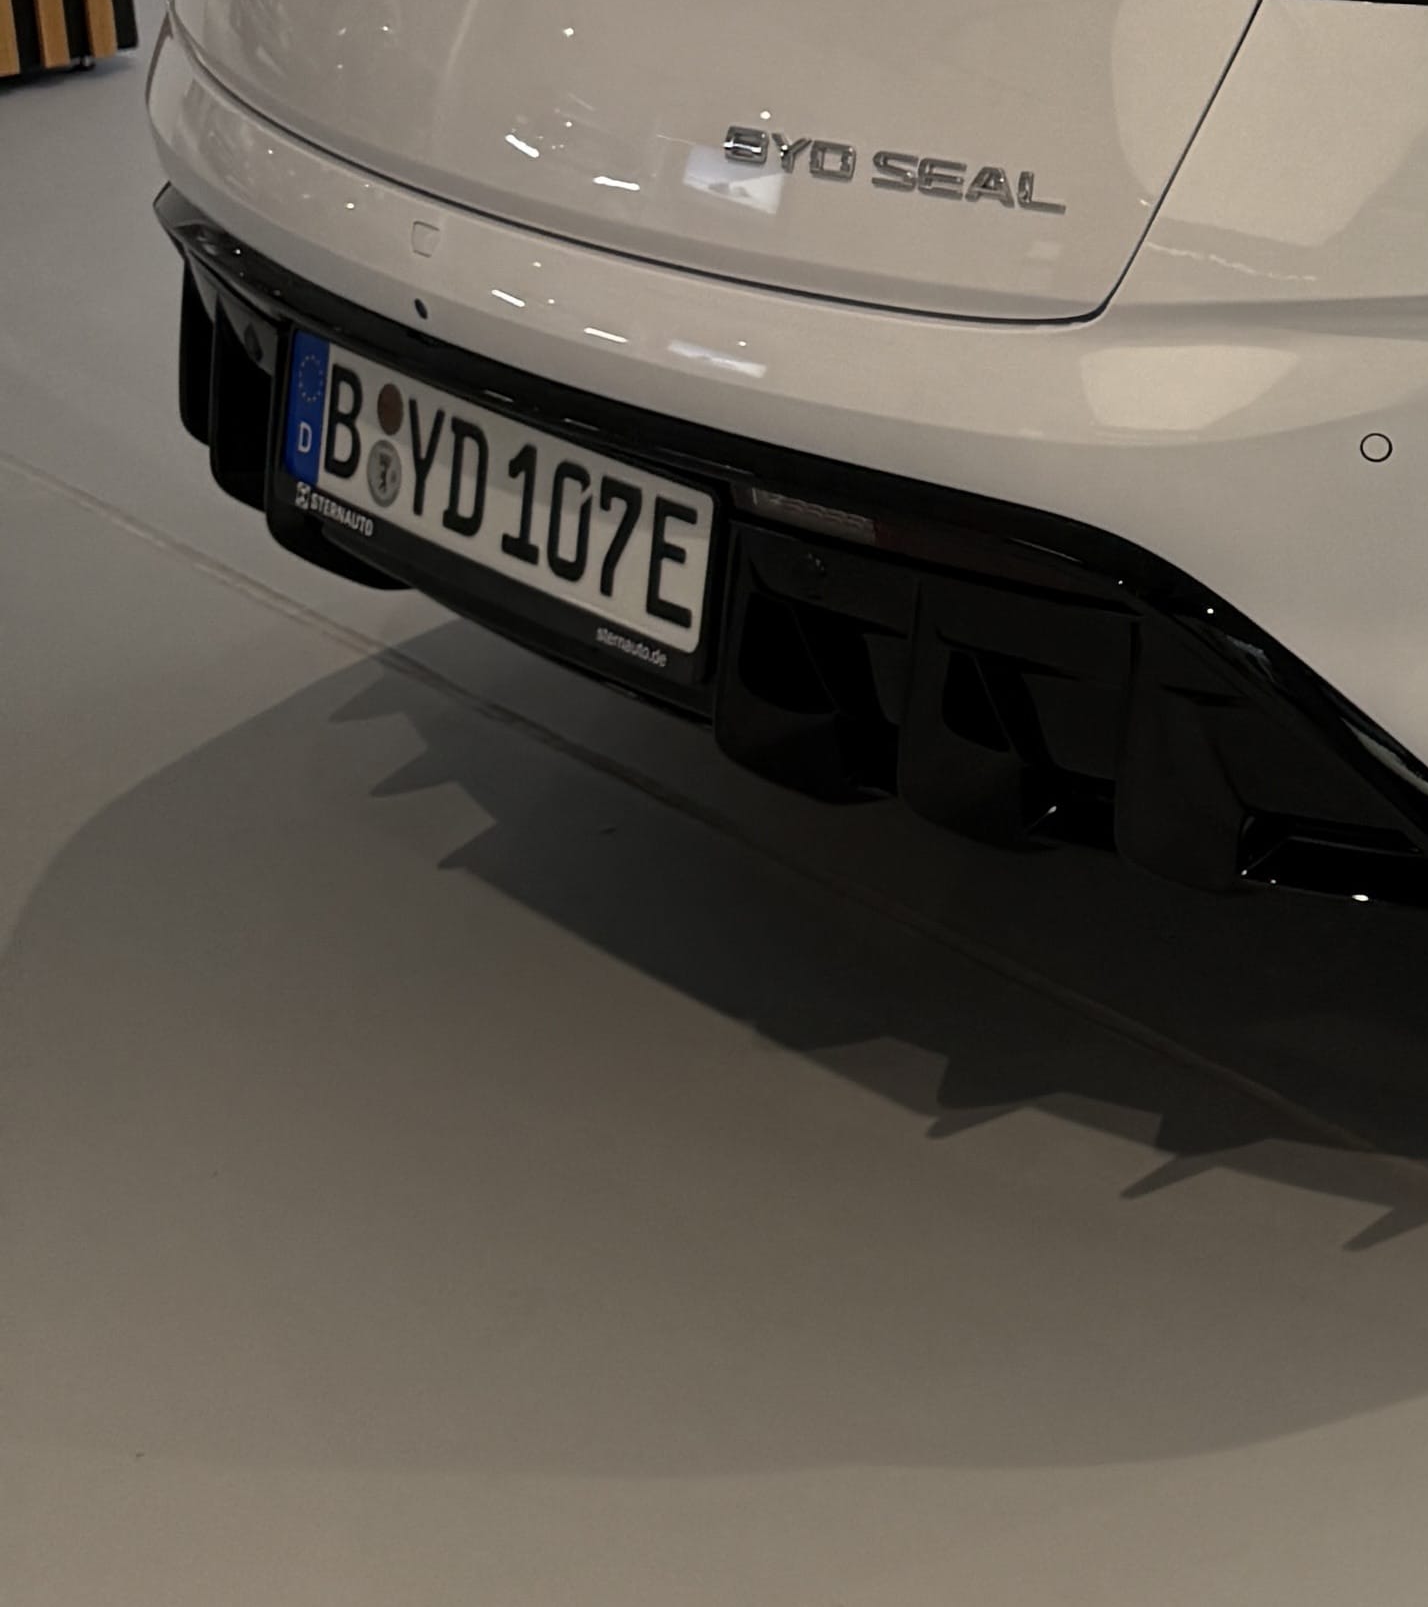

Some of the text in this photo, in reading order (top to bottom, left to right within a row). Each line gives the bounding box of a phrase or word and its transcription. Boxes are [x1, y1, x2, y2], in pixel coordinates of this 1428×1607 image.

[723, 125, 1066, 215] BYD SEAL
[296, 421, 313, 454] D
[310, 492, 374, 537] STERNAUTO
[323, 363, 364, 480] B
[500, 443, 699, 631] 107E
[597, 627, 667, 668] sternauto.de
